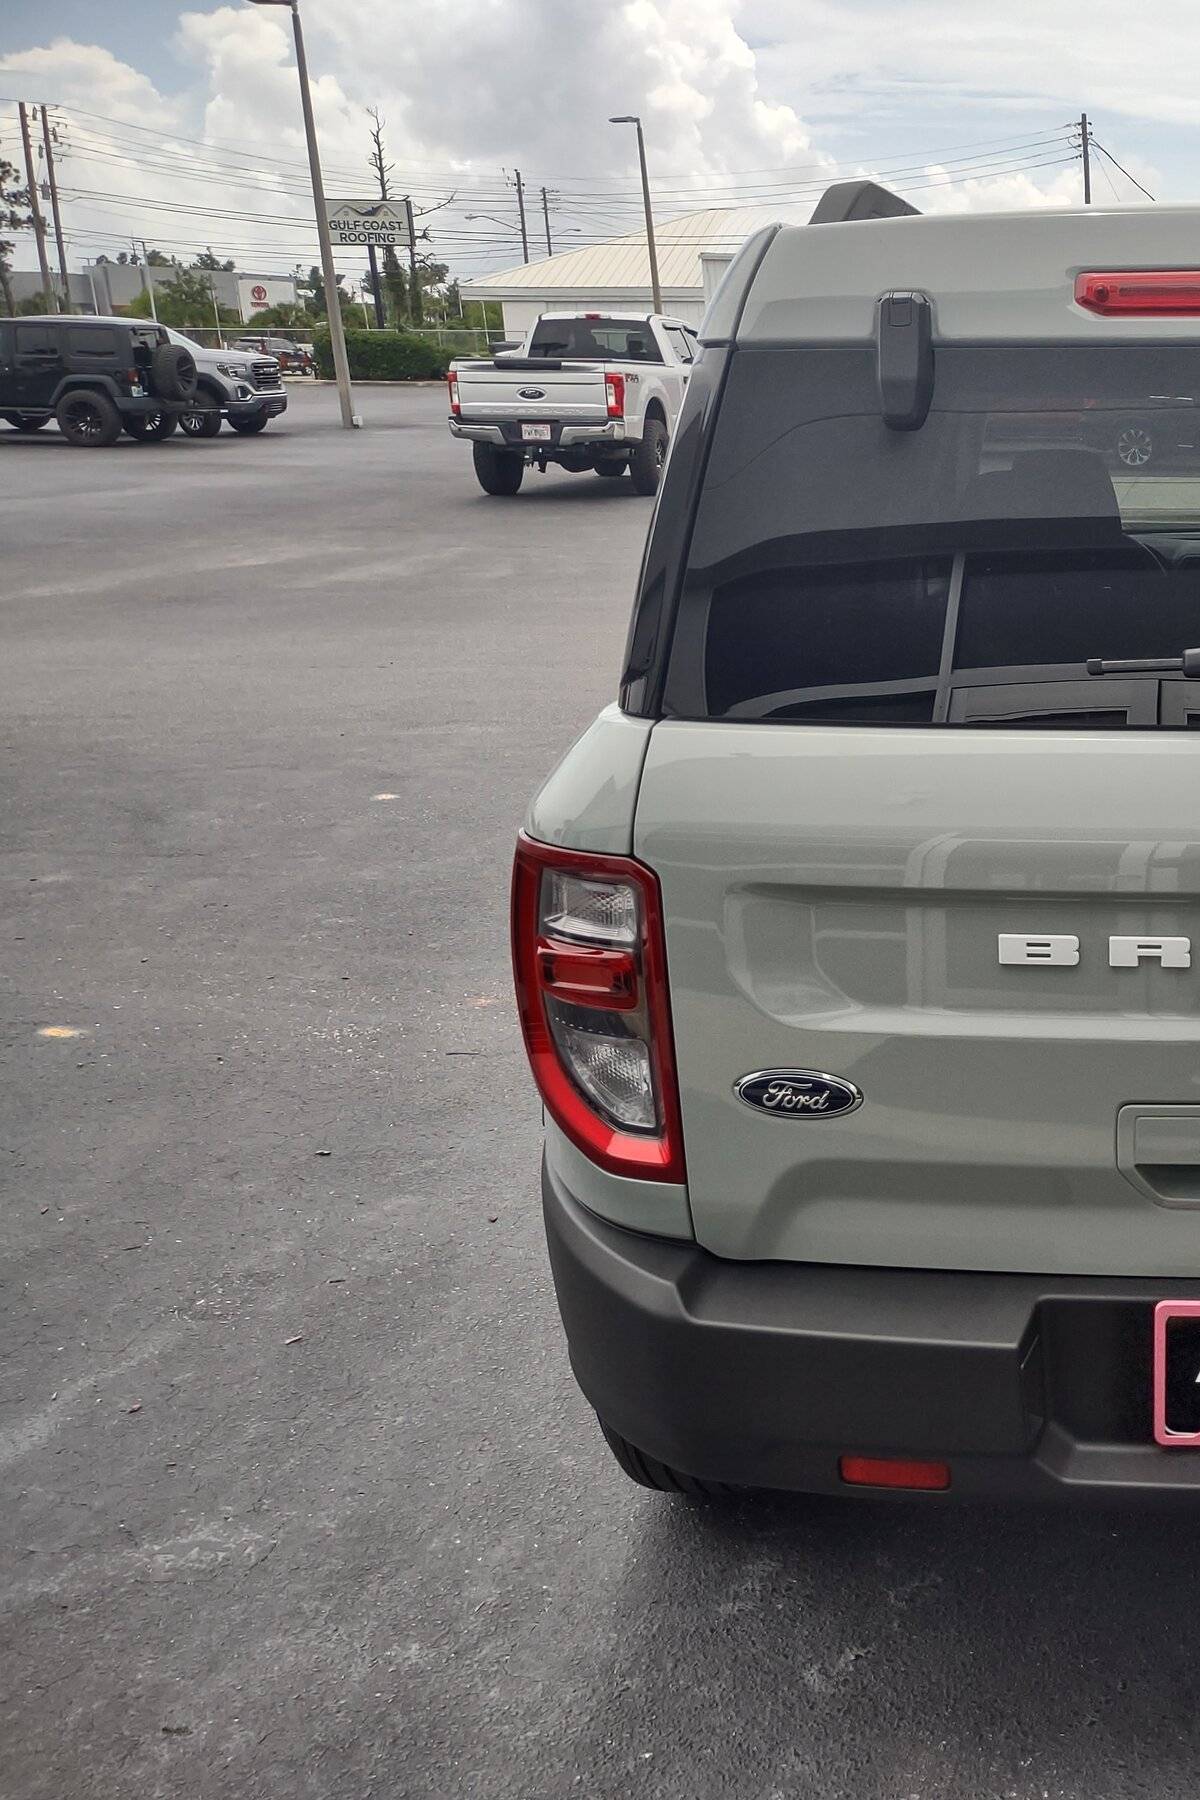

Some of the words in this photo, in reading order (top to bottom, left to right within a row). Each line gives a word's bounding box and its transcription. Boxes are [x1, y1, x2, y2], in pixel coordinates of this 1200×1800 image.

[328, 220, 361, 231] GULF
[362, 220, 403, 231] COAST
[340, 232, 396, 243] ROOFING
[762, 1080, 831, 1110] Ford
